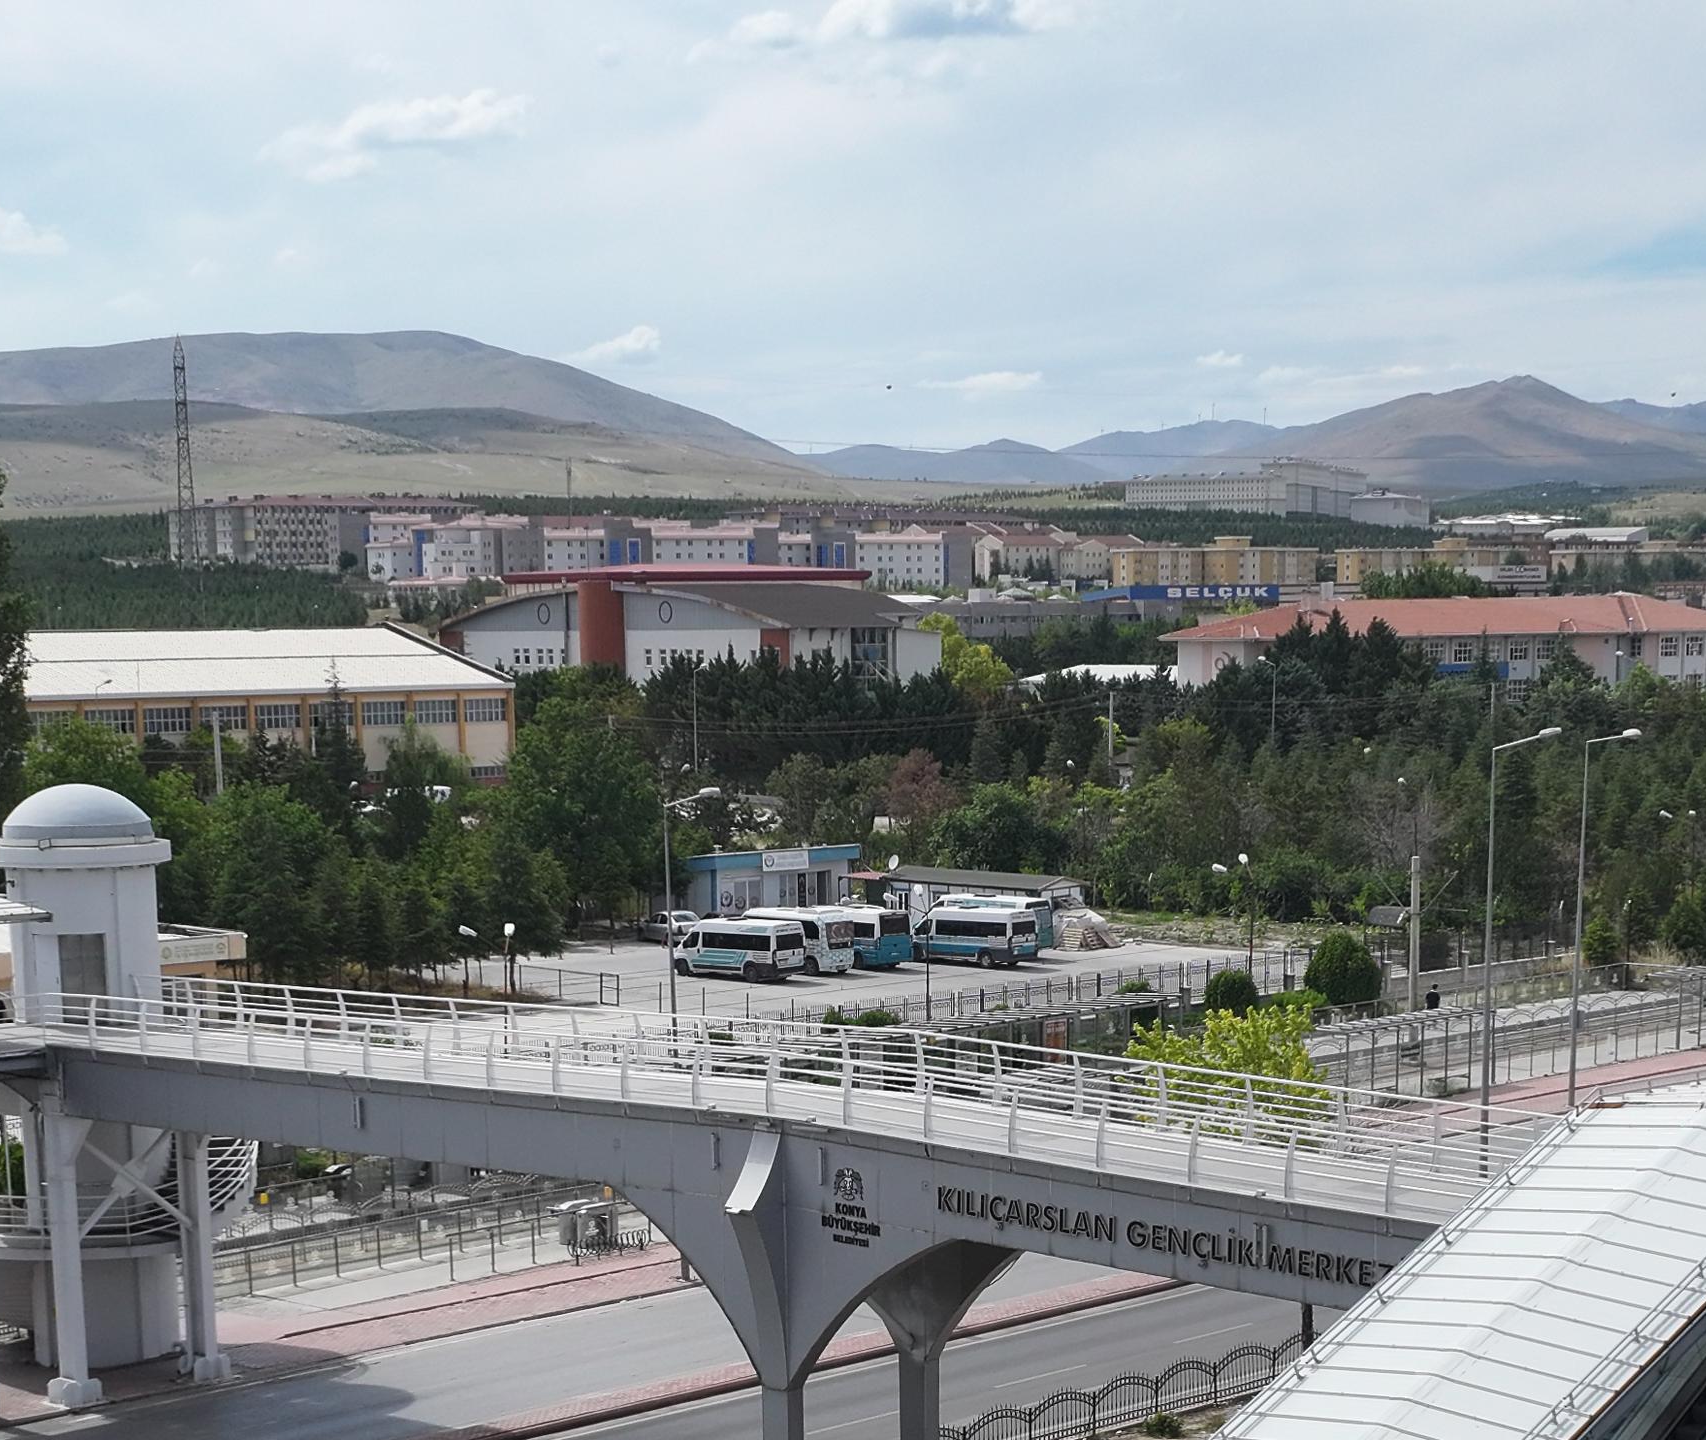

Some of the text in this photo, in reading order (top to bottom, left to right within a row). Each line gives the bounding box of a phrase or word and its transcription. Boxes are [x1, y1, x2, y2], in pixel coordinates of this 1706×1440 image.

[1167, 586, 1269, 599] SELÇUK
[835, 1202, 867, 1219] KONYA
[821, 1214, 881, 1237] BÜYÜKŞEHİR
[937, 1185, 1406, 1287] KILIÇARSLAN GENÇLİK MERKEZ
